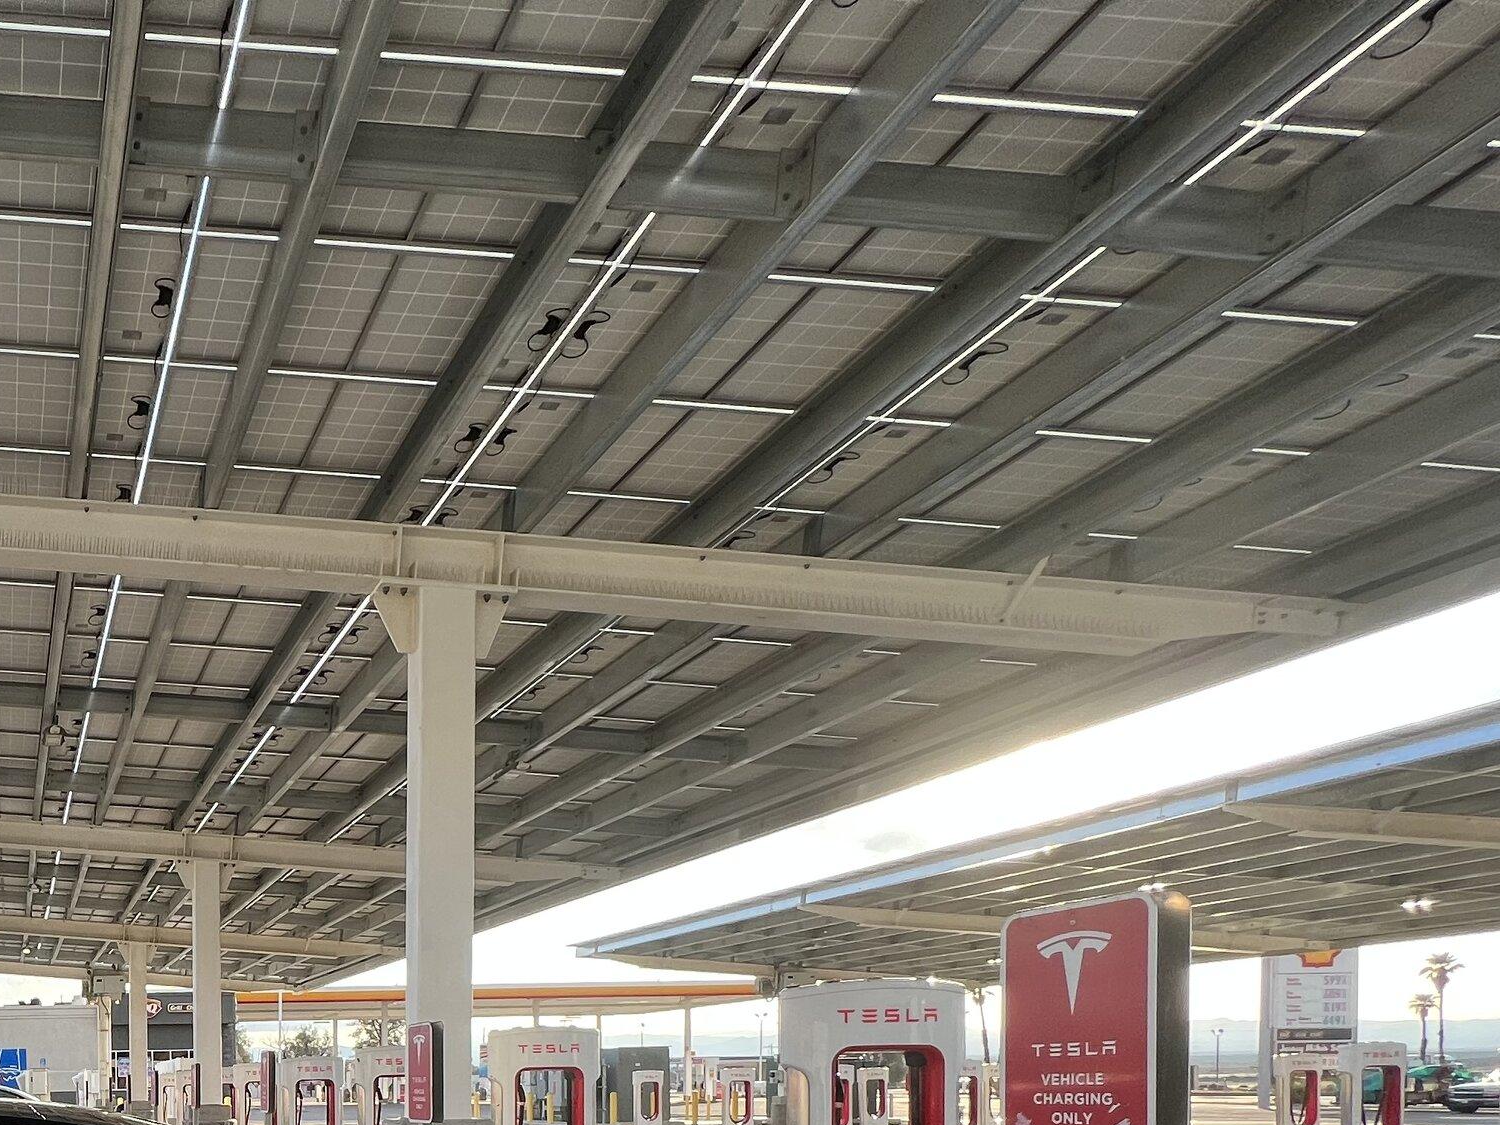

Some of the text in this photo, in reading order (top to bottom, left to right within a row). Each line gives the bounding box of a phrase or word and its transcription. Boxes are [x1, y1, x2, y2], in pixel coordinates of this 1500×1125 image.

[837, 1008, 938, 1024] TESLA
[518, 1043, 580, 1054] TESLA
[1031, 1040, 1117, 1057] TESLA
[375, 1058, 403, 1066] TES
[1041, 1073, 1104, 1086] VEHICLE
[1033, 1093, 1113, 1105] CHARGING
[1051, 1112, 1093, 1125] ONLY
